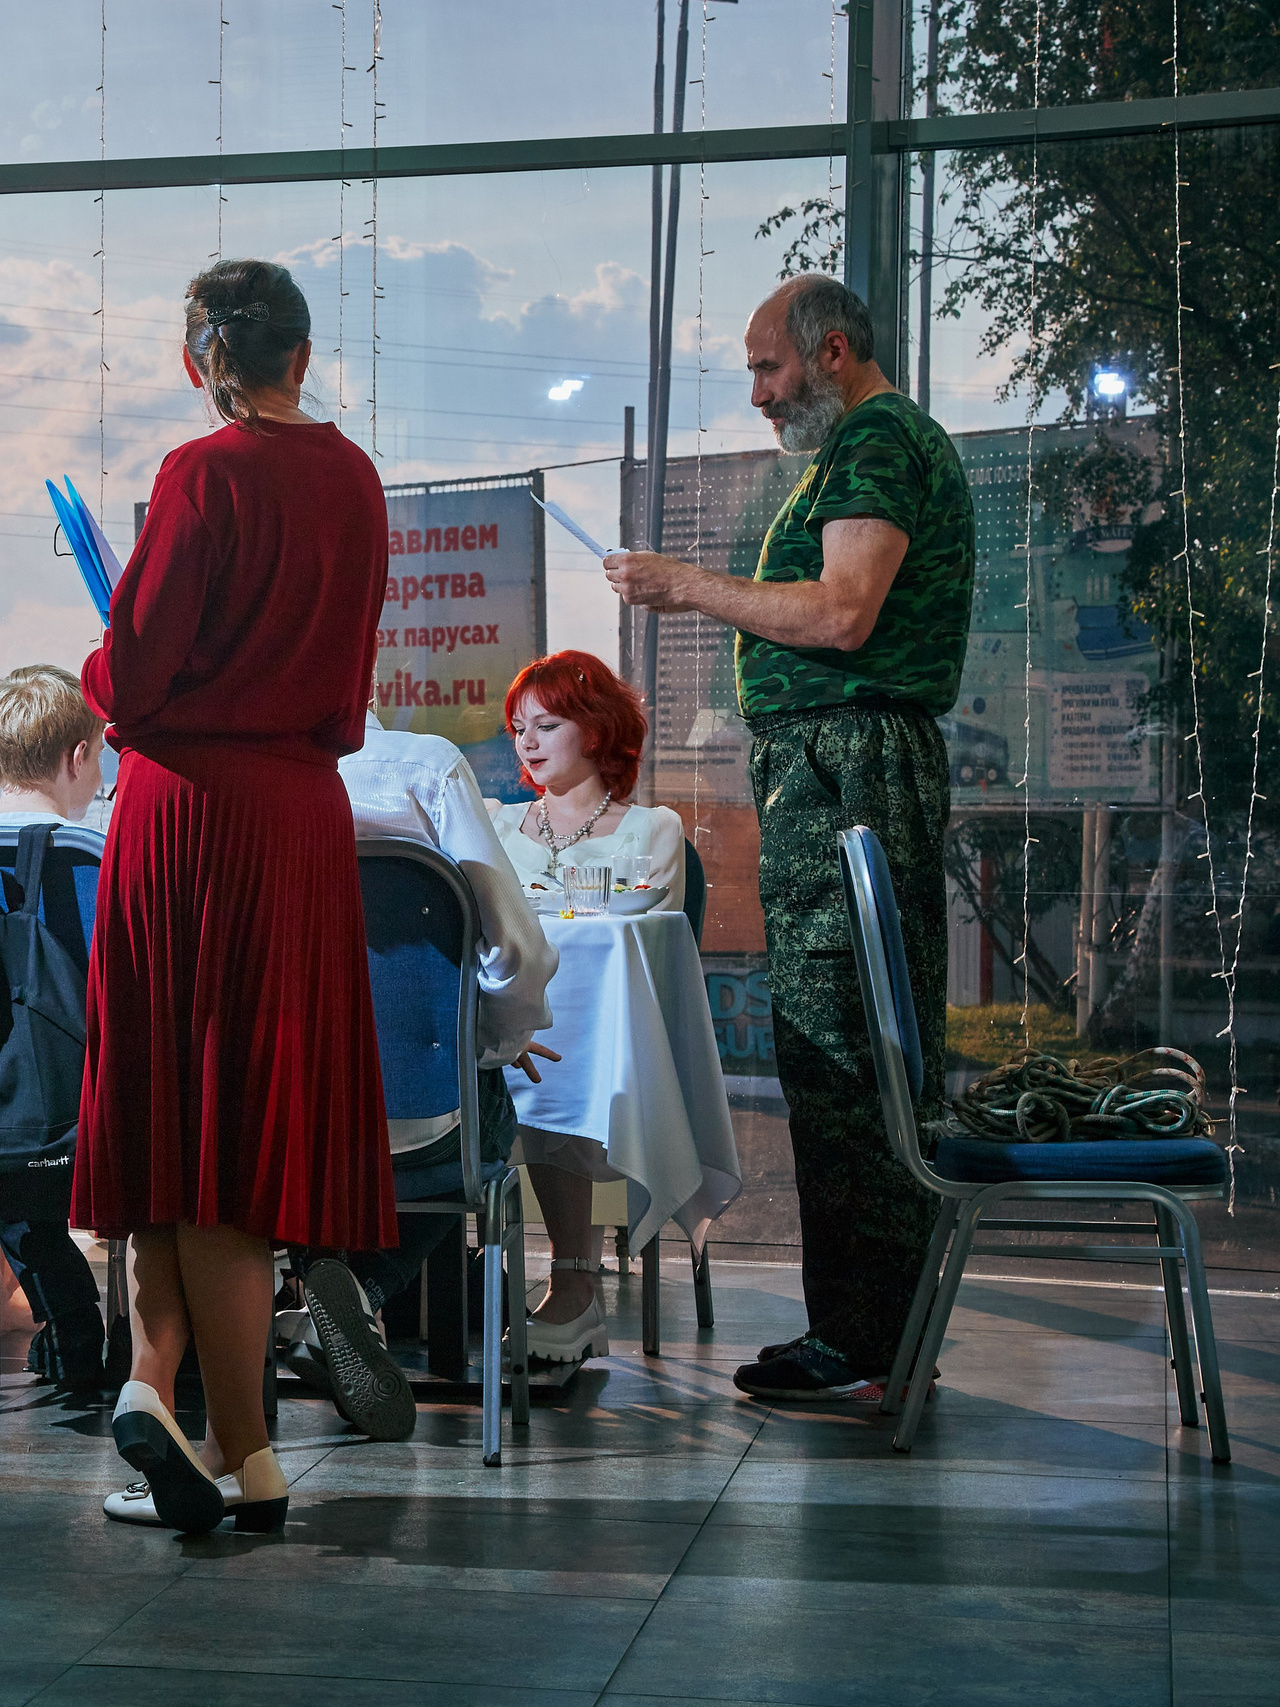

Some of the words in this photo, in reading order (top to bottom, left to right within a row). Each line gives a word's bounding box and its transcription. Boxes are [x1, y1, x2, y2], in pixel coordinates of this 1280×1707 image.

[388, 523, 498, 556] авляем
[384, 572, 486, 610] арства
[404, 624, 500, 653] парусах
[371, 669, 486, 707] vika.ru
[27, 1155, 70, 1168] carhartt
